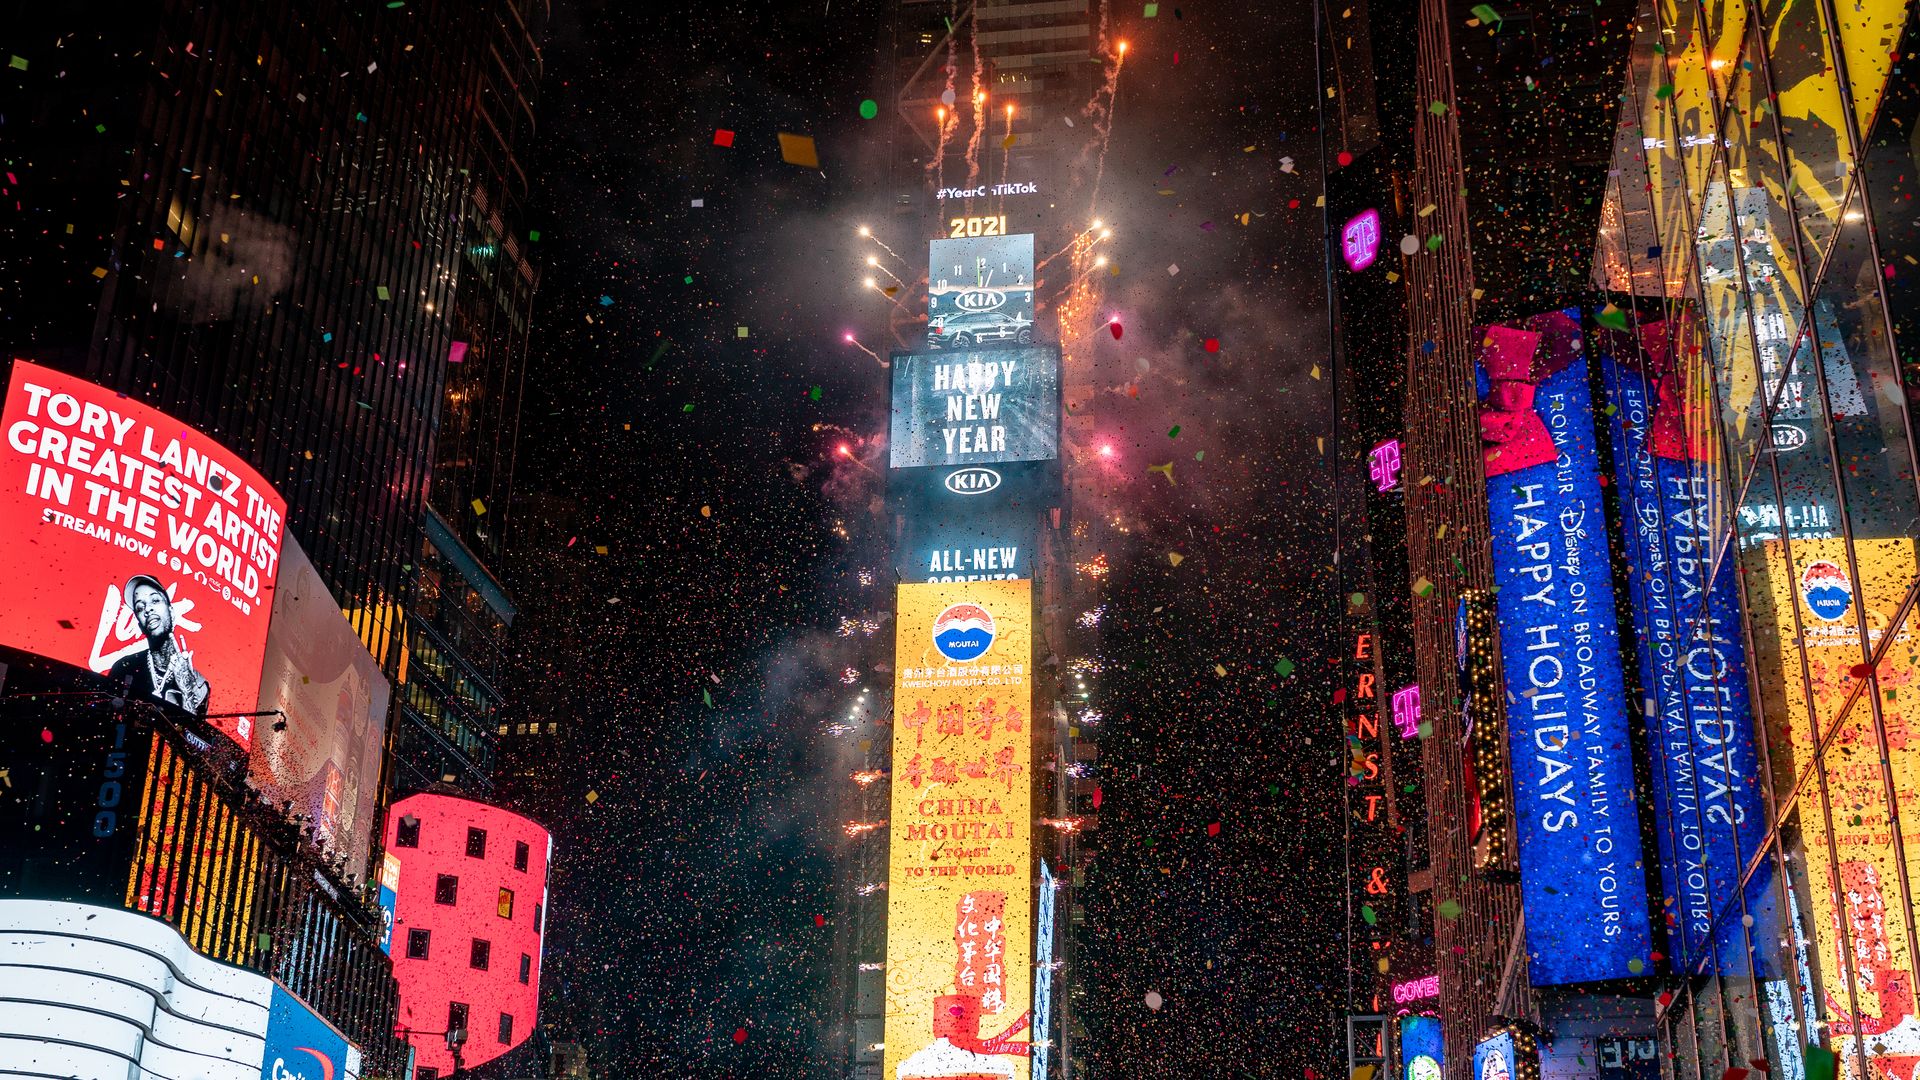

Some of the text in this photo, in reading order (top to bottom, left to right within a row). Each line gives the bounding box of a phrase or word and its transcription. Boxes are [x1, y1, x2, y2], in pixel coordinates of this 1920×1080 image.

[950, 215, 1006, 239] 2021
[1346, 214, 1377, 265] T
[954, 265, 962, 276] 11
[1002, 262, 1007, 273] 1
[1017, 275, 1024, 286] 2
[937, 279, 947, 290] 10
[1024, 292, 1031, 303] 3
[930, 297, 938, 308] 9
[964, 293, 998, 307] KIA
[934, 361, 1016, 391] HAPPY
[947, 394, 1001, 422] NEW
[1549, 393, 1567, 451] FROM
[942, 425, 1006, 454] YEAR
[24, 382, 281, 544] TORY LANEZ THE
[1369, 439, 1401, 492] T
[1556, 454, 1574, 495] OUR
[954, 473, 991, 490] KIA
[8, 420, 278, 578] GREATEST ARTIST
[25, 463, 261, 606] IN THE WORLD.
[41, 507, 153, 559] STREAM NOW
[929, 546, 1018, 572] ALL-NEW
[1570, 582, 1588, 614] ON
[948, 640, 979, 648] MOUTAI
[1511, 483, 1579, 833] HAPPY HOLIDAYS
[902, 679, 951, 689] KWEICHOW
[952, 678, 984, 687] MOUTA
[1573, 622, 1601, 739] BROADWAY
[1393, 685, 1421, 738] T
[93, 723, 127, 838] 1500
[1587, 744, 1611, 819] FAMILY
[919, 798, 1003, 817] CHINA
[906, 822, 1015, 841] MOUTAI
[1595, 825, 1613, 854] TO
[944, 847, 990, 859] TOAST
[905, 864, 1016, 877] TO THE WORLD
[1367, 867, 1390, 895] &
